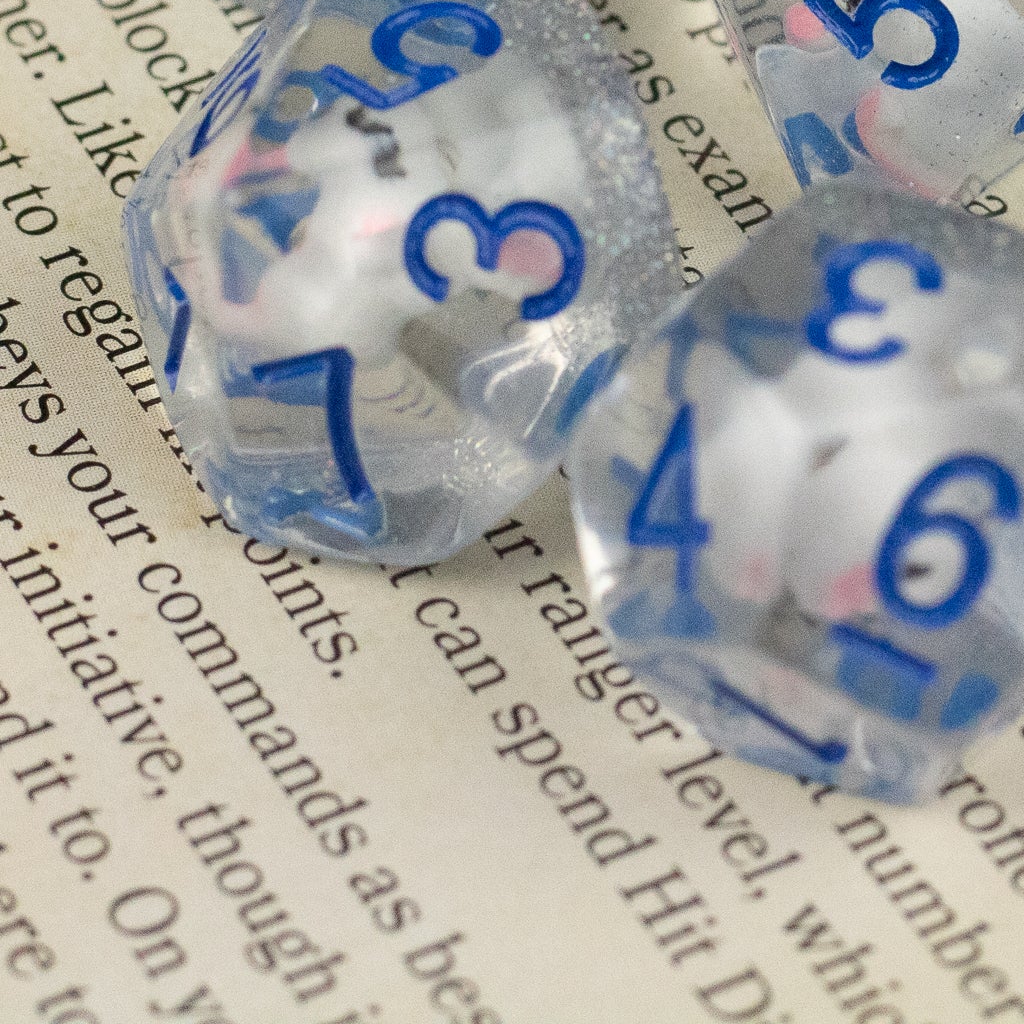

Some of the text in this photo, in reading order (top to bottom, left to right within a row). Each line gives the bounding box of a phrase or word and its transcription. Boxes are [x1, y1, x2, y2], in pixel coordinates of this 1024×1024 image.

[323, 0, 503, 111] 5
[619, 48, 676, 106] as
[2, 184, 58, 236] to
[403, 192, 586, 321] 3
[803, 239, 946, 366] 3
[252, 345, 378, 506] 7
[627, 402, 711, 598] 4
[27, 427, 157, 548] your
[137, 561, 370, 858] commands
[346, 865, 423, 936] as
[521, 568, 682, 743] ranger
[661, 746, 802, 901] level,
[0, 540, 186, 801] initiative,
[176, 802, 349, 1005] though
[413, 595, 506, 695] can
[491, 700, 659, 867] spend
[617, 864, 721, 968] Hit
[12, 751, 77, 804] it
[47, 804, 113, 883] to.
[105, 884, 189, 980] On
